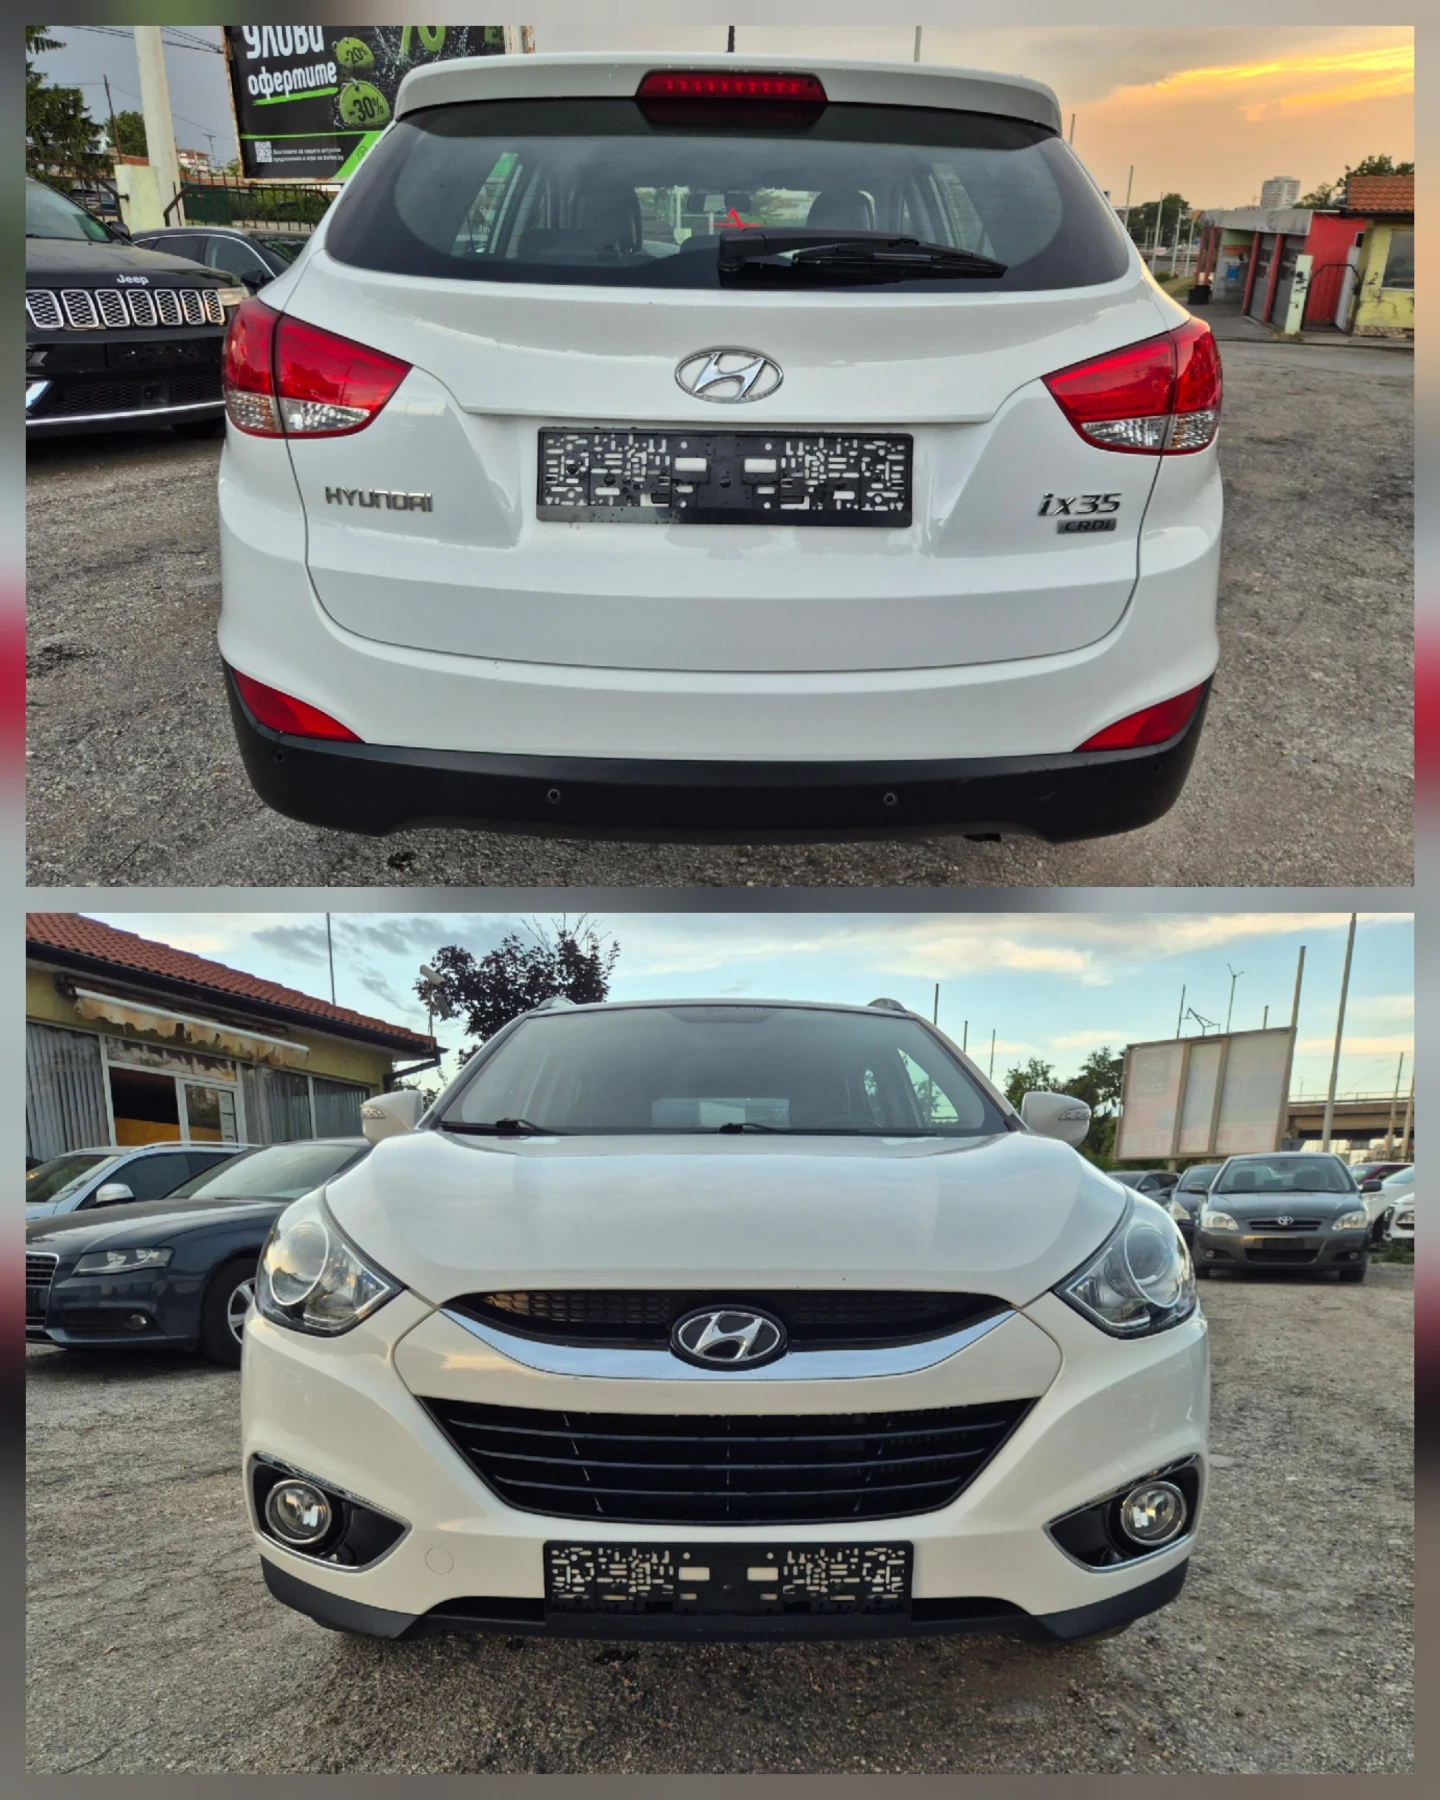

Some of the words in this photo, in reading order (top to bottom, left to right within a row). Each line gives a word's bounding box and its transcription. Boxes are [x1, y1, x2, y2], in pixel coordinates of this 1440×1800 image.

[247, 61, 338, 100] офертите
[348, 96, 385, 122] -30%
[116, 273, 149, 286] Jeep
[325, 486, 433, 513] HYUNDAI
[1037, 492, 1122, 517] ix35
